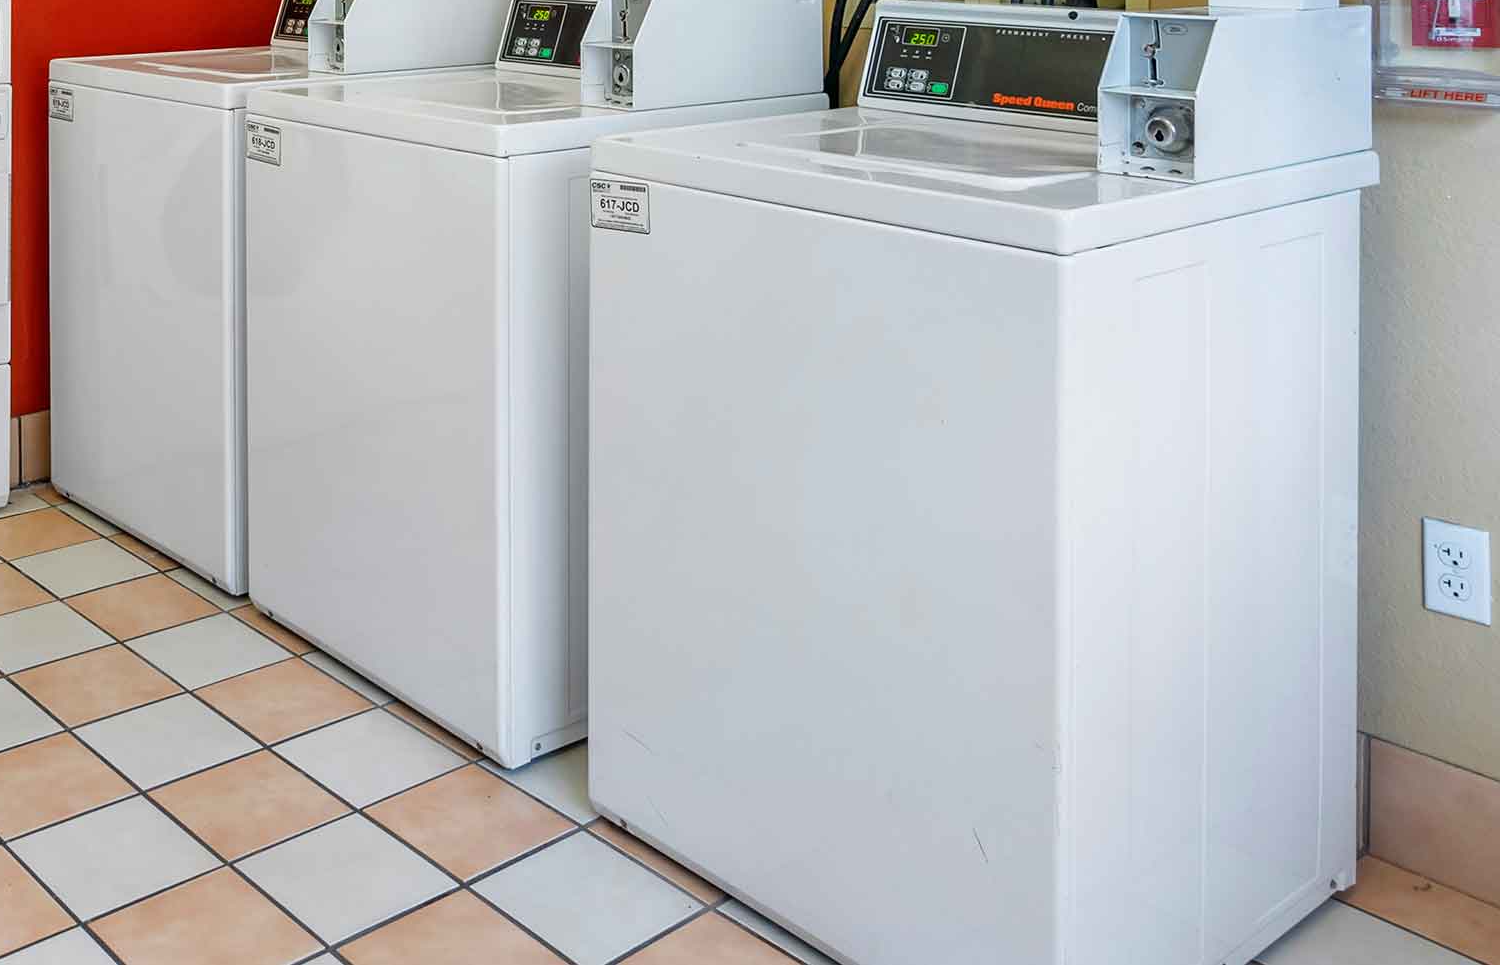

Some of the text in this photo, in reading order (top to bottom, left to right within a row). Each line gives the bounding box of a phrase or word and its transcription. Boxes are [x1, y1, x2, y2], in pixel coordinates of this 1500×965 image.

[910, 33, 935, 45] 250
[992, 93, 1032, 106] Speed
[1033, 96, 1075, 110] Queen
[1411, 89, 1486, 102] LIFT HERE
[600, 198, 640, 213] 617-JCD
